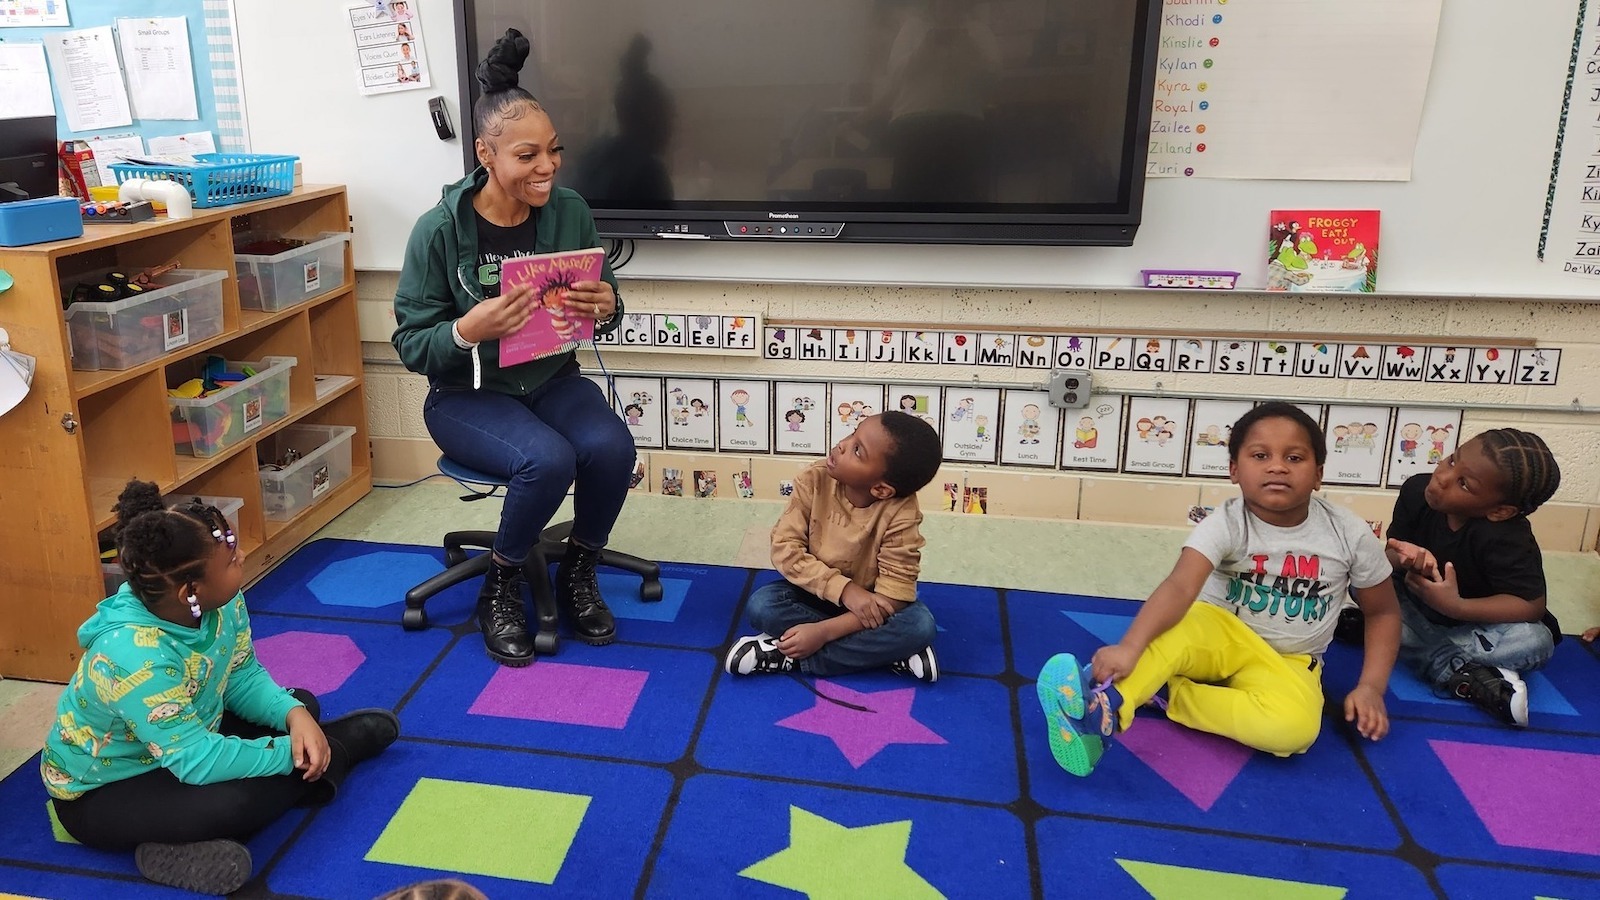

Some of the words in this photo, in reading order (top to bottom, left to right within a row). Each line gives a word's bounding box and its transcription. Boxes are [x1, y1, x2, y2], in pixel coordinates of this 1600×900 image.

[352, 13, 366, 22] Eyes
[1165, 14, 1205, 26] Khodi
[373, 30, 396, 39] Listening
[1162, 36, 1203, 48] Kinslie
[364, 52, 382, 61] Voices
[382, 50, 398, 58] Quiet
[1159, 57, 1197, 74] Kylan
[365, 72, 383, 81] Bodies
[1157, 79, 1190, 96] Kyra
[1155, 100, 1194, 116] Royal
[1151, 120, 1191, 133] Zailee
[1149, 141, 1192, 154] Ziland
[1147, 161, 1178, 175] Zuri
[1308, 217, 1359, 229] FROGGY
[1321, 228, 1348, 238] EATS
[1333, 237, 1356, 246] OUT
[517, 261, 546, 281] Like
[548, 254, 597, 273] Myself!
[730, 438, 749, 446] Clean
[750, 439, 757, 447] Up
[954, 442, 982, 450] Outside/
[959, 450, 976, 458] Gym
[1152, 461, 1175, 469] Group
[1250, 554, 1269, 574] I
[1281, 553, 1320, 580] AM
